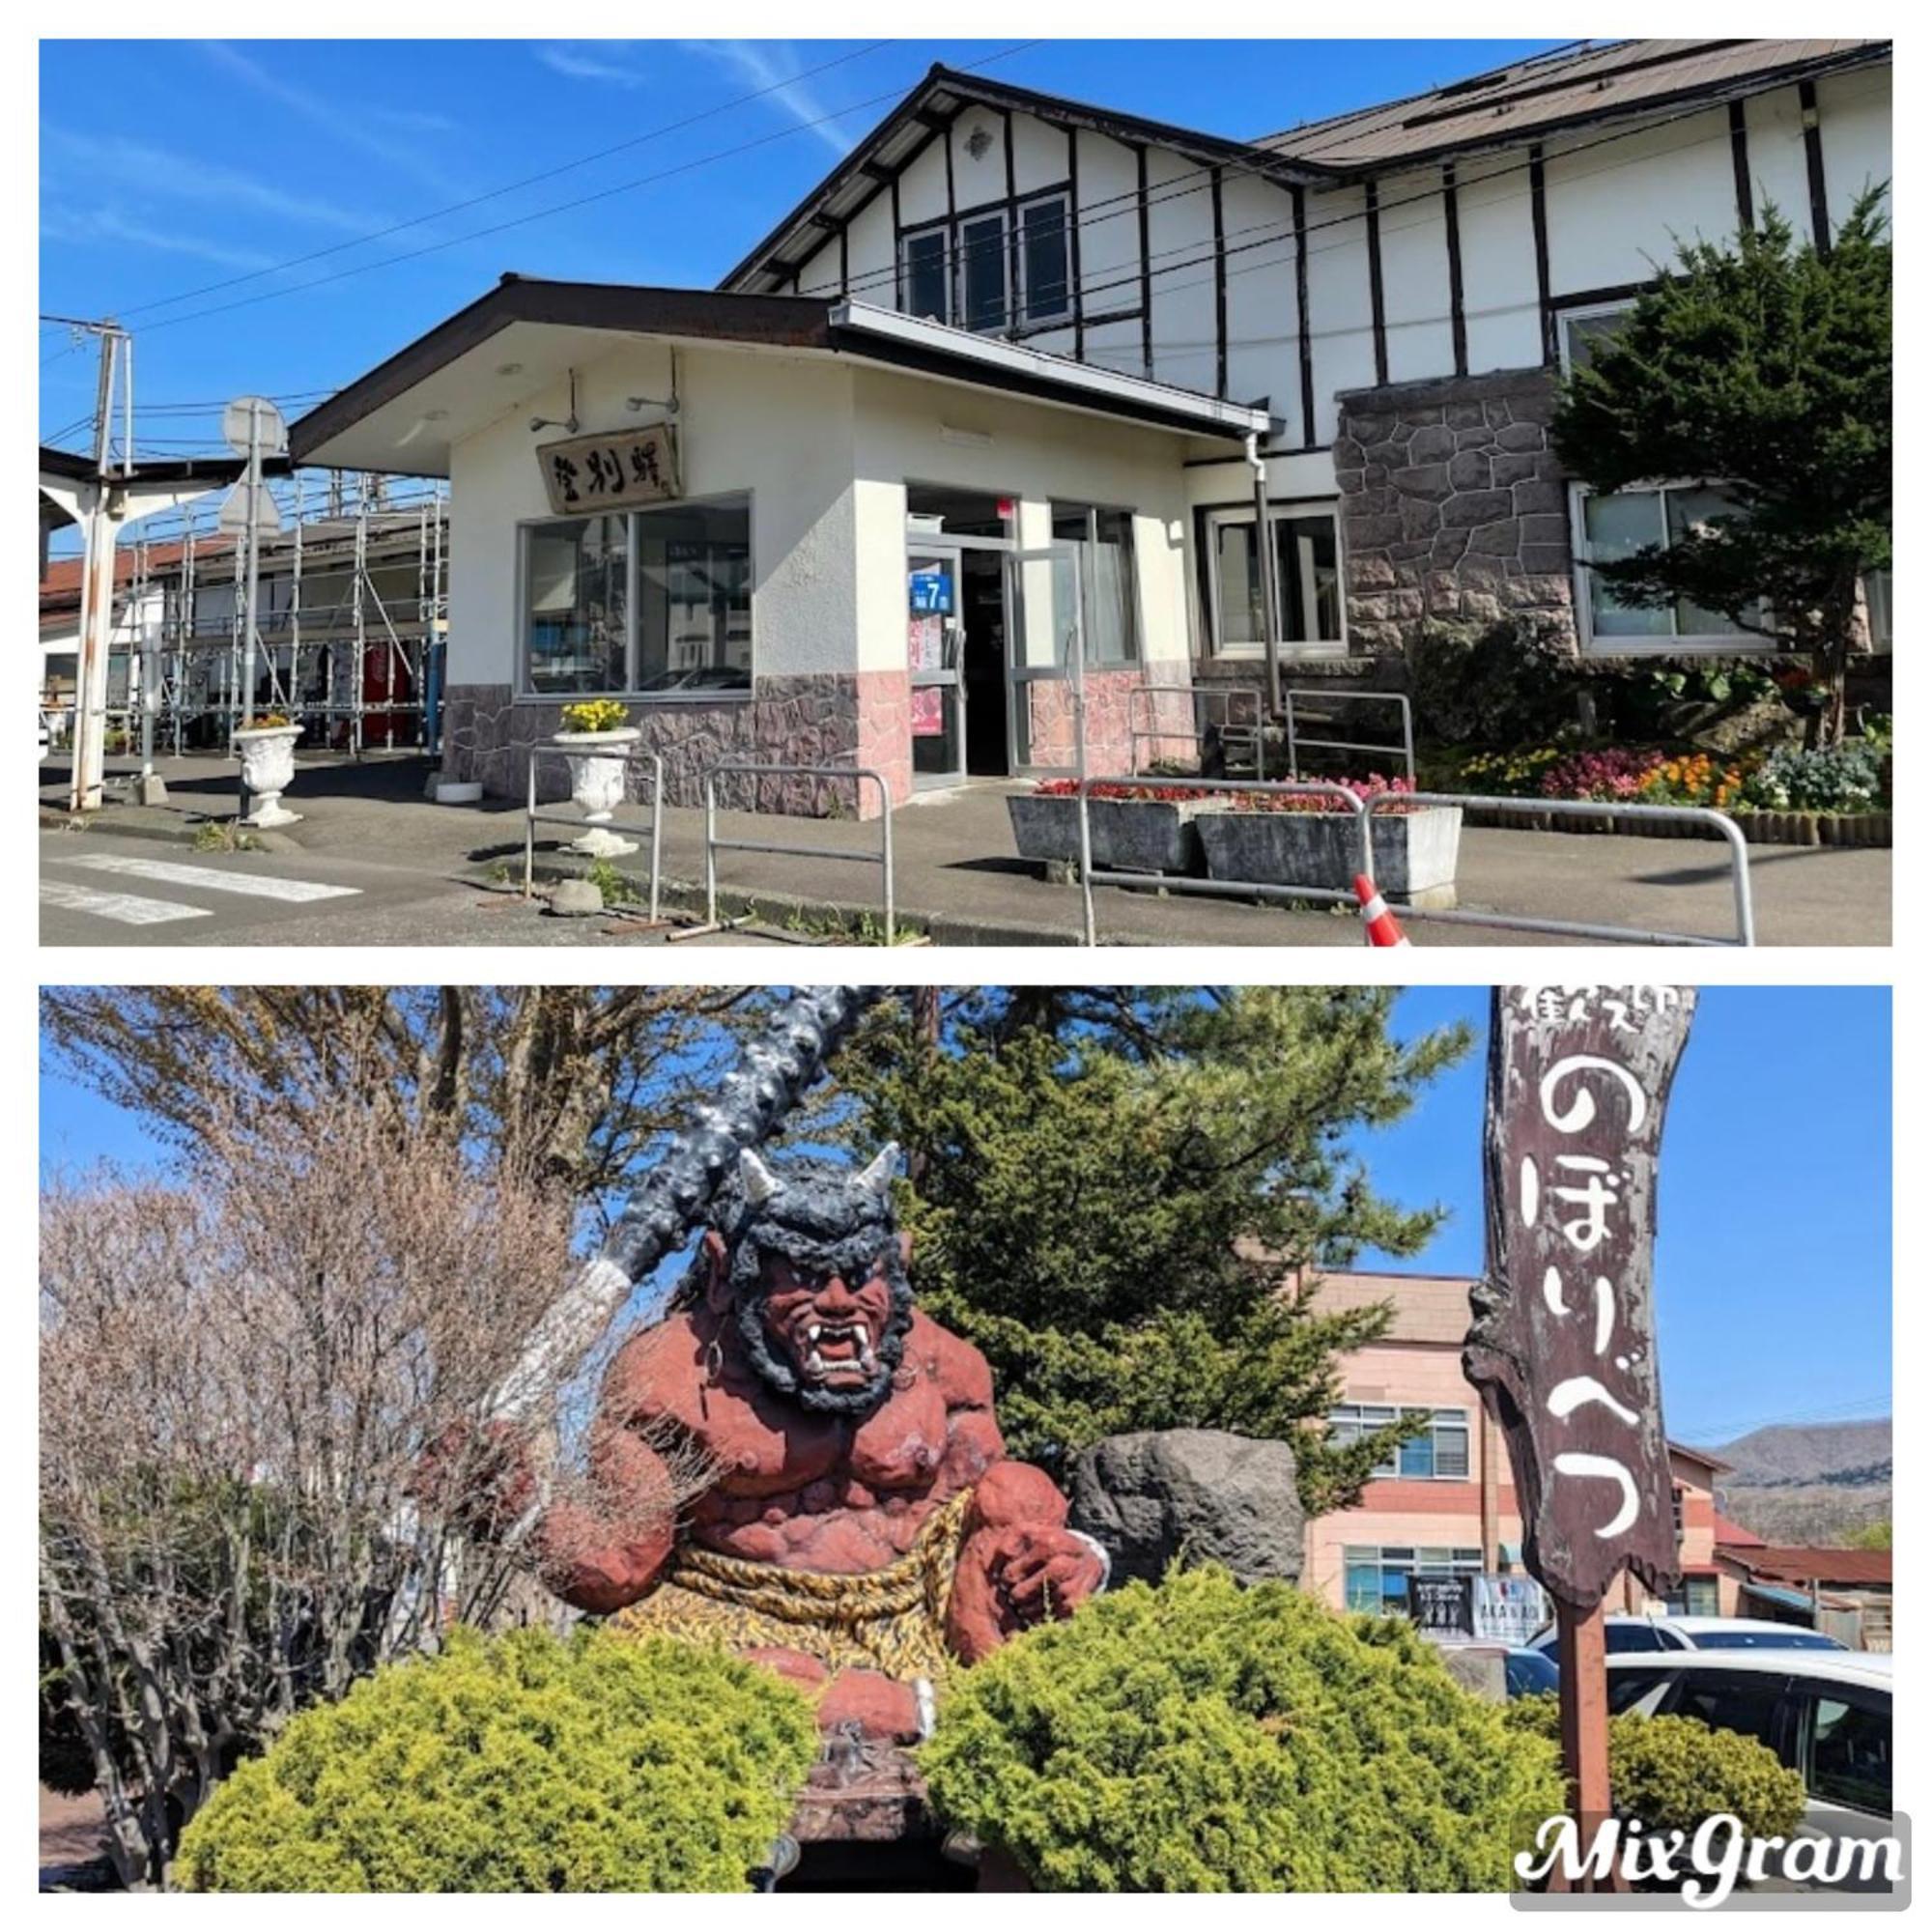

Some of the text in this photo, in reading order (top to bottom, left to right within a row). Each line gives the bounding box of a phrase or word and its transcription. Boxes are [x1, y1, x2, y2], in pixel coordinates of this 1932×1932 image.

[1520, 1055, 1646, 1538] のぼりべつ
